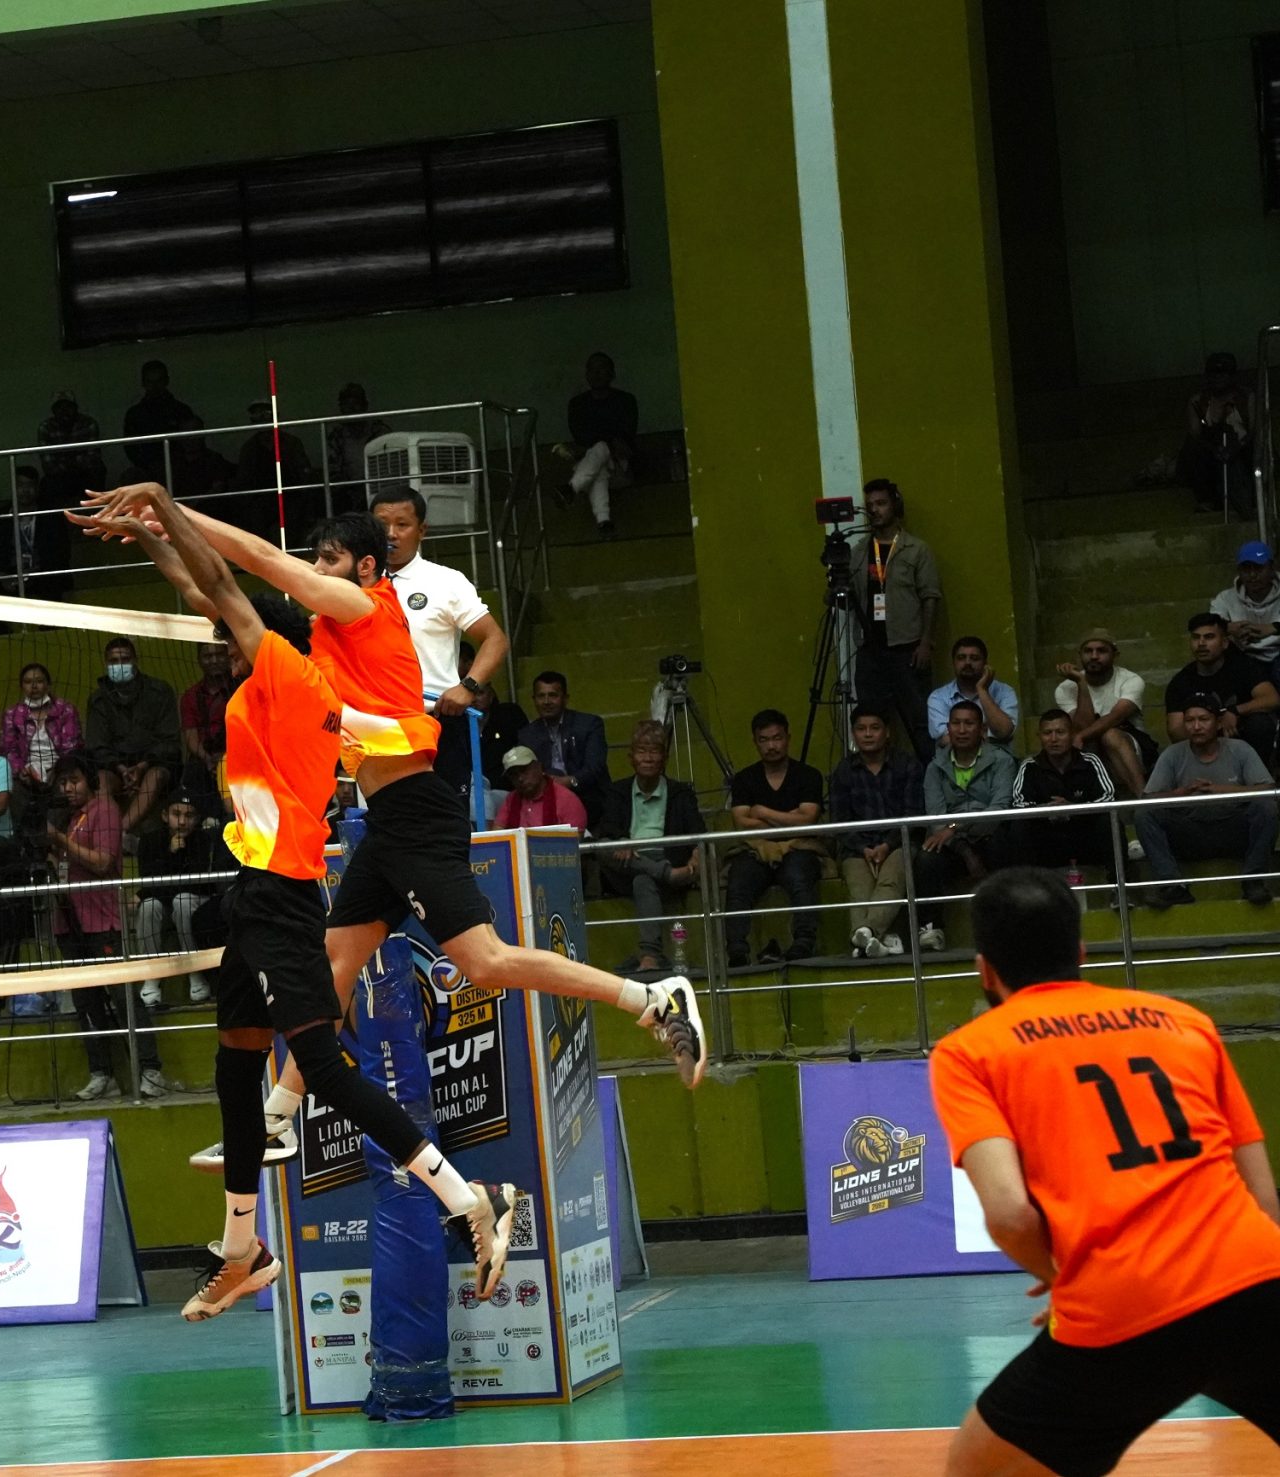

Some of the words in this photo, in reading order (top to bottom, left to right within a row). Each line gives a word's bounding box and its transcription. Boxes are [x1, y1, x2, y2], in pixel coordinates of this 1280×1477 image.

[408, 890, 426, 921] 5
[258, 971, 275, 1006] 2
[456, 986, 496, 1007] DISTRICT
[458, 1011, 476, 1027] 325
[478, 1006, 486, 1020] M
[574, 1017, 589, 1061] CUP
[426, 1030, 495, 1077] CUP
[465, 1094, 487, 1114] CUP
[1075, 1056, 1203, 1172] 11
[319, 1118, 360, 1143] LION
[322, 1134, 362, 1161] VOLLEY
[834, 1169, 880, 1193] LIONS
[888, 1158, 920, 1177] CUP
[838, 1191, 859, 1202] LIONS
[861, 1174, 916, 1195] INTERNATIONAL
[840, 1196, 870, 1210] VOLLEYBALL
[871, 1188, 904, 1201] INVITATIONAL
[904, 1183, 915, 1192] CUP
[324, 1219, 369, 1236] 18-22
[462, 1378, 503, 1388] REVEL
